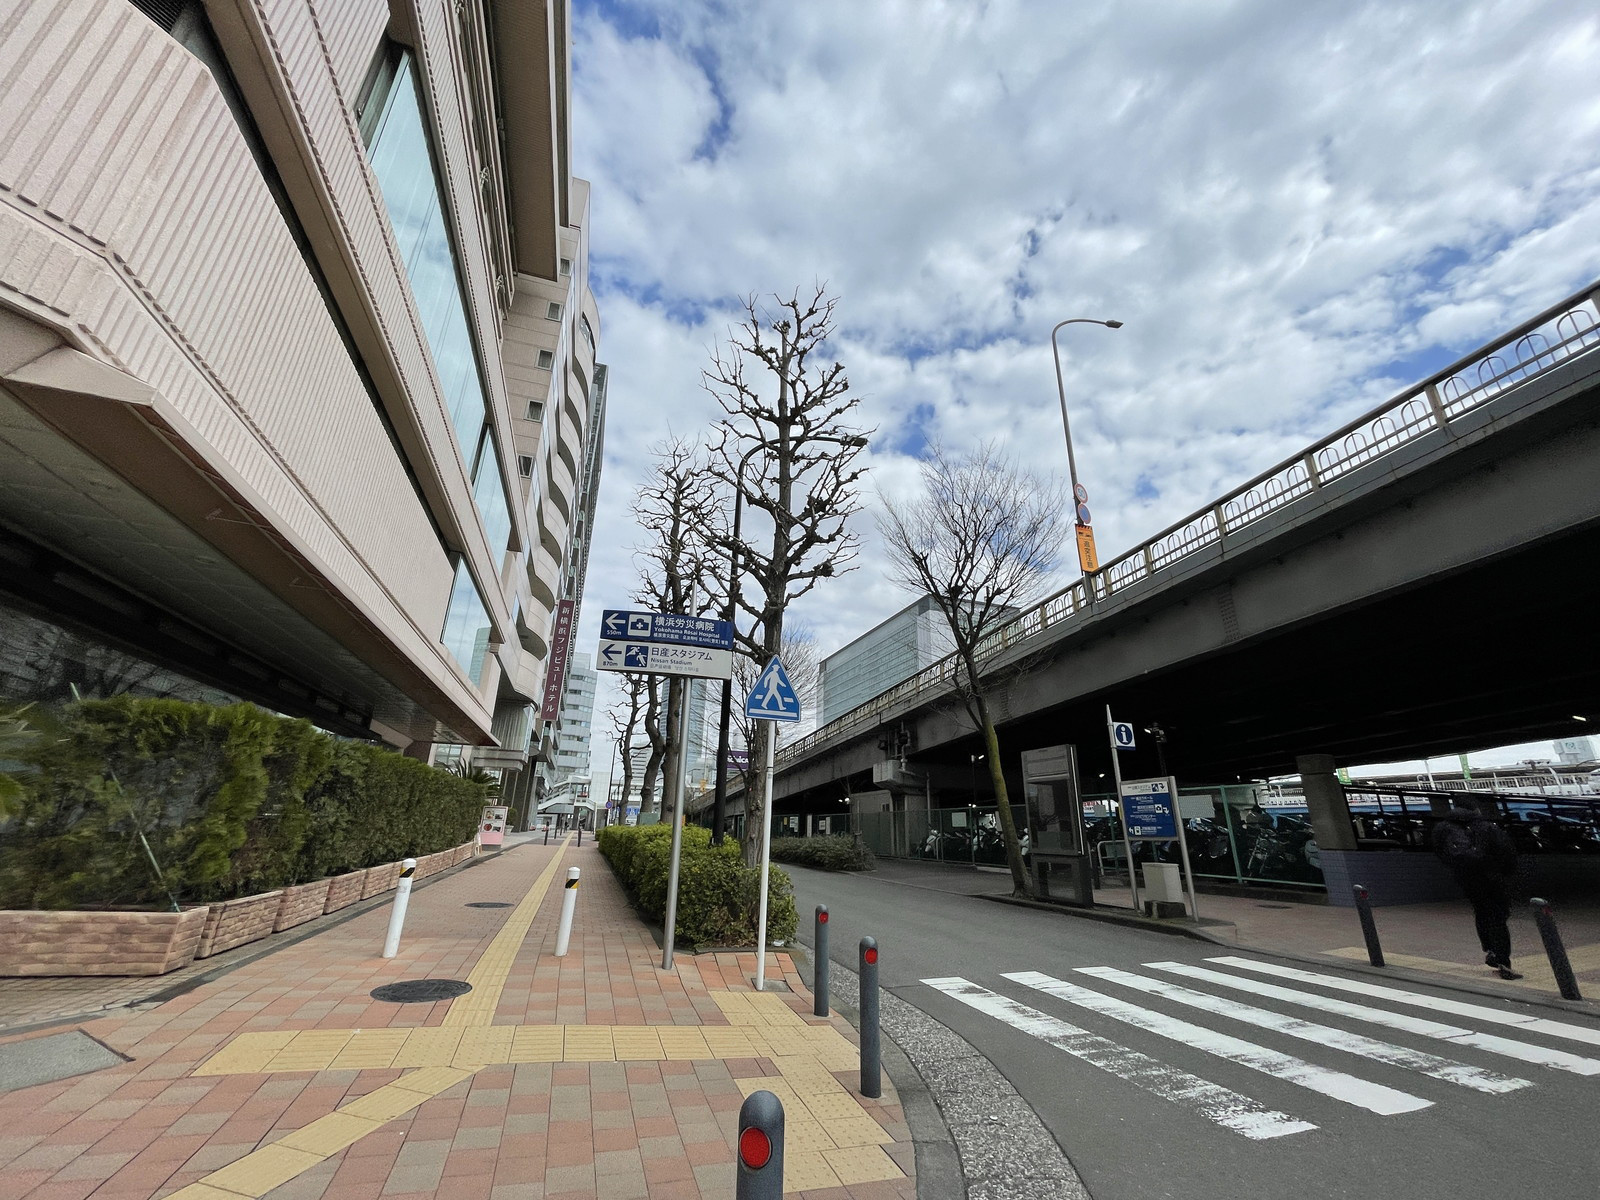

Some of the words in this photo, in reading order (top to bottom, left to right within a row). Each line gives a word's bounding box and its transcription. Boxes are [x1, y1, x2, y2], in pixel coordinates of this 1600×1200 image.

[654, 615, 715, 632] 横浜労災病院
[654, 626, 683, 634] Yokohama
[698, 630, 720, 639] Hospital
[545, 606, 571, 713] 新横浜フジビューホテル
[651, 647, 713, 661] 日産スタジアム
[650, 657, 669, 665] Nissan
[669, 658, 693, 667] Stadium
